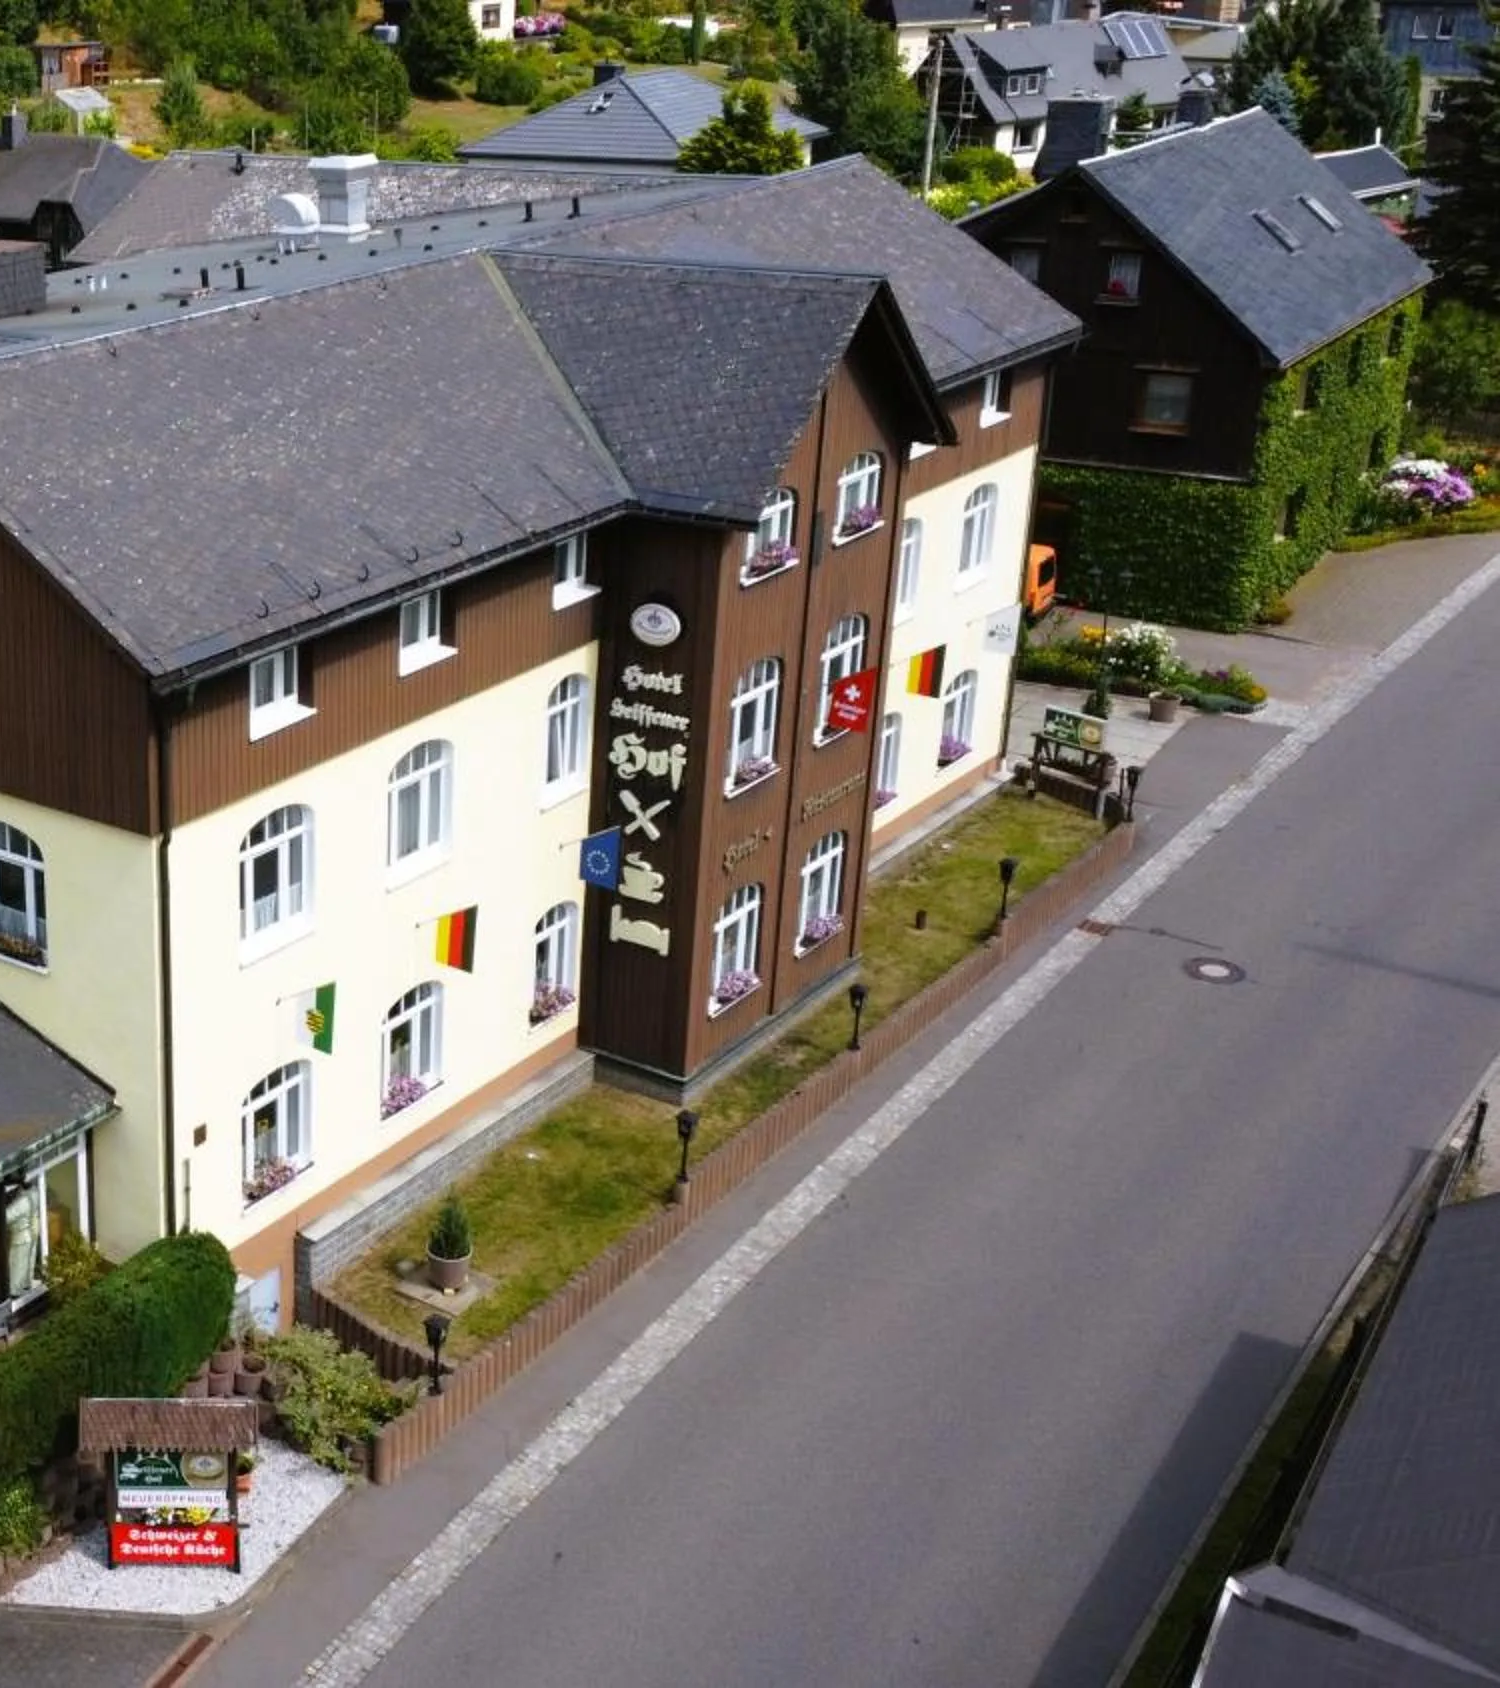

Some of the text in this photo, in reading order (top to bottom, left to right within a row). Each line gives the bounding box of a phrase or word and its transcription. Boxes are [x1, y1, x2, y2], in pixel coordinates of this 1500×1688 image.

[609, 697, 690, 731] Seiffener
[609, 732, 687, 792] Hof
[129, 1528, 199, 1543] Schweizer
[119, 1542, 180, 1557] Deutsche
